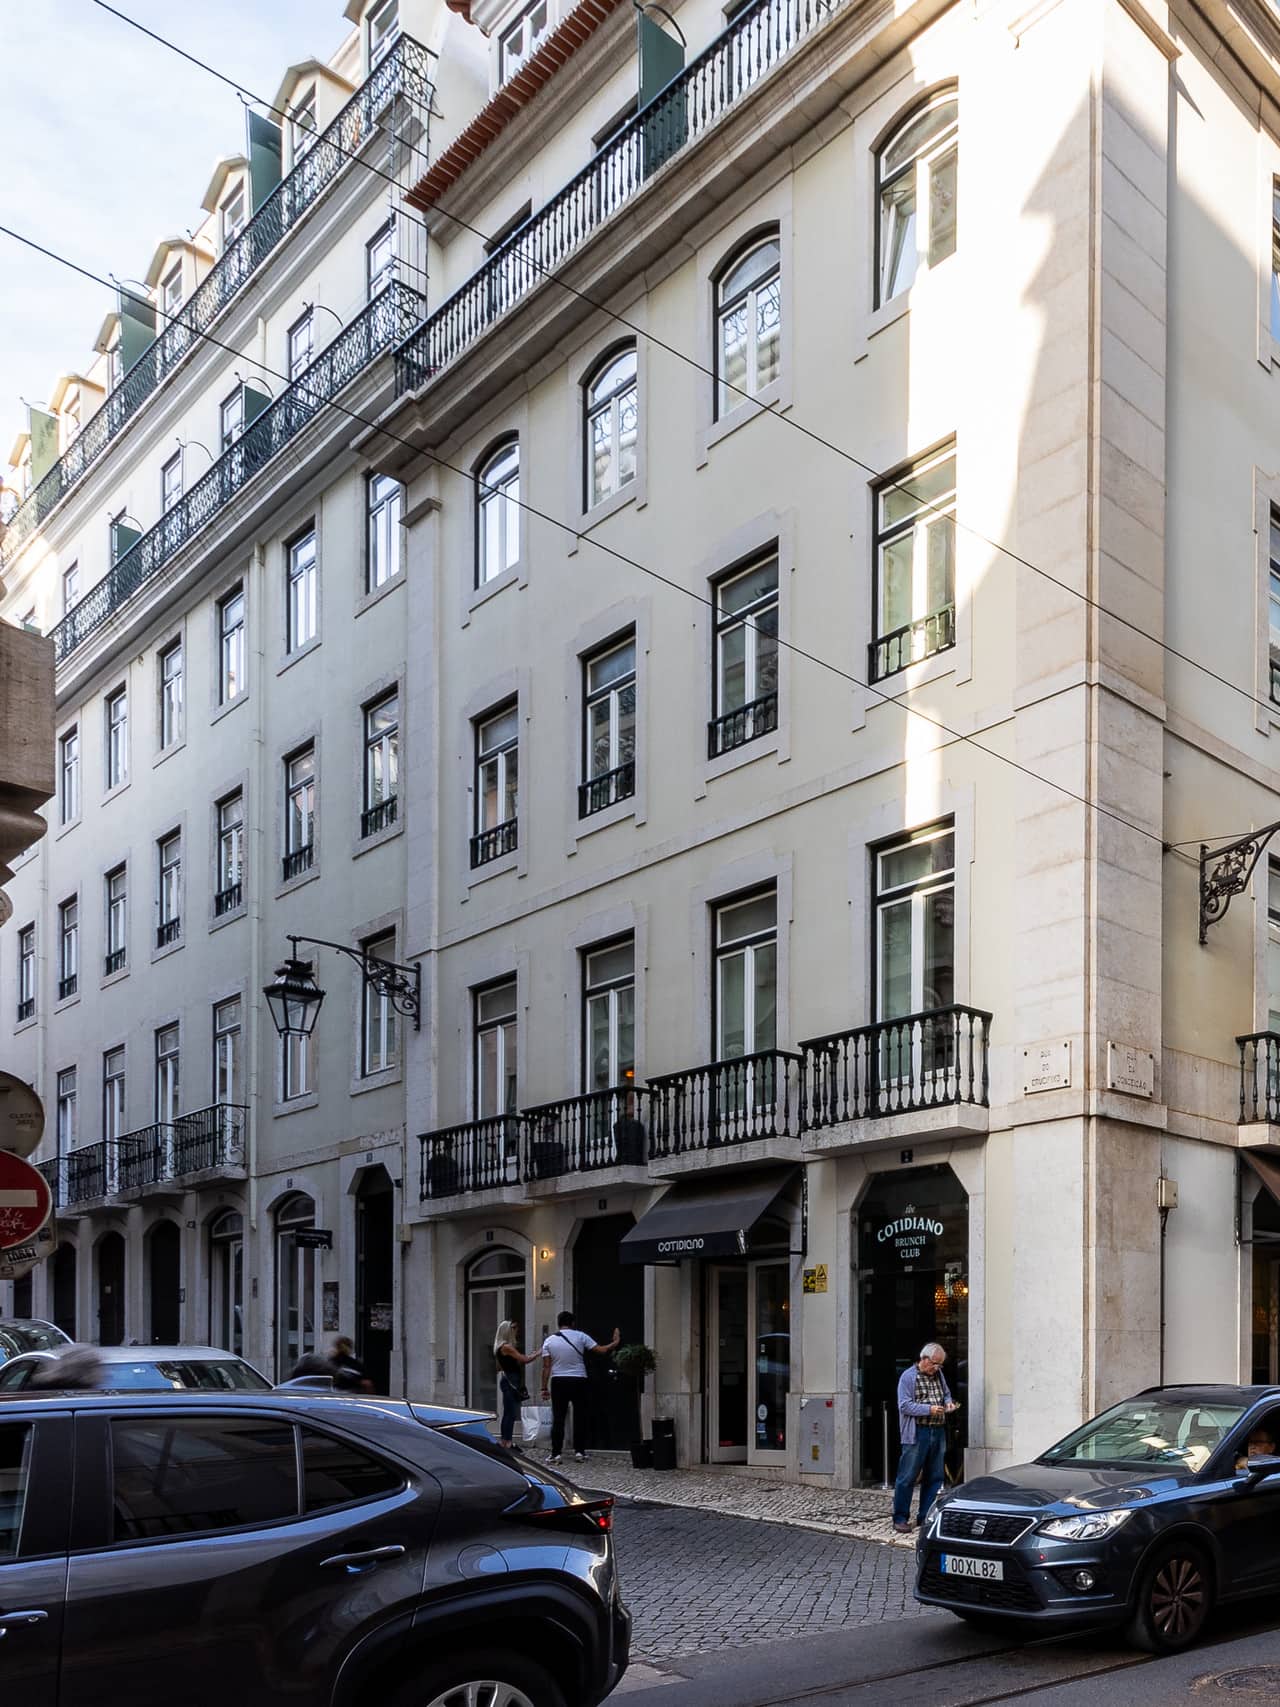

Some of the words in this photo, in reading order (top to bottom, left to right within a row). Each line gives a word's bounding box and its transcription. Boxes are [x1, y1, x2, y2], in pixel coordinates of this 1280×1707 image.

[877, 1216, 944, 1242] COTIDIANO
[895, 1235, 926, 1247] BRUNCH
[900, 1248, 920, 1258] CLUB
